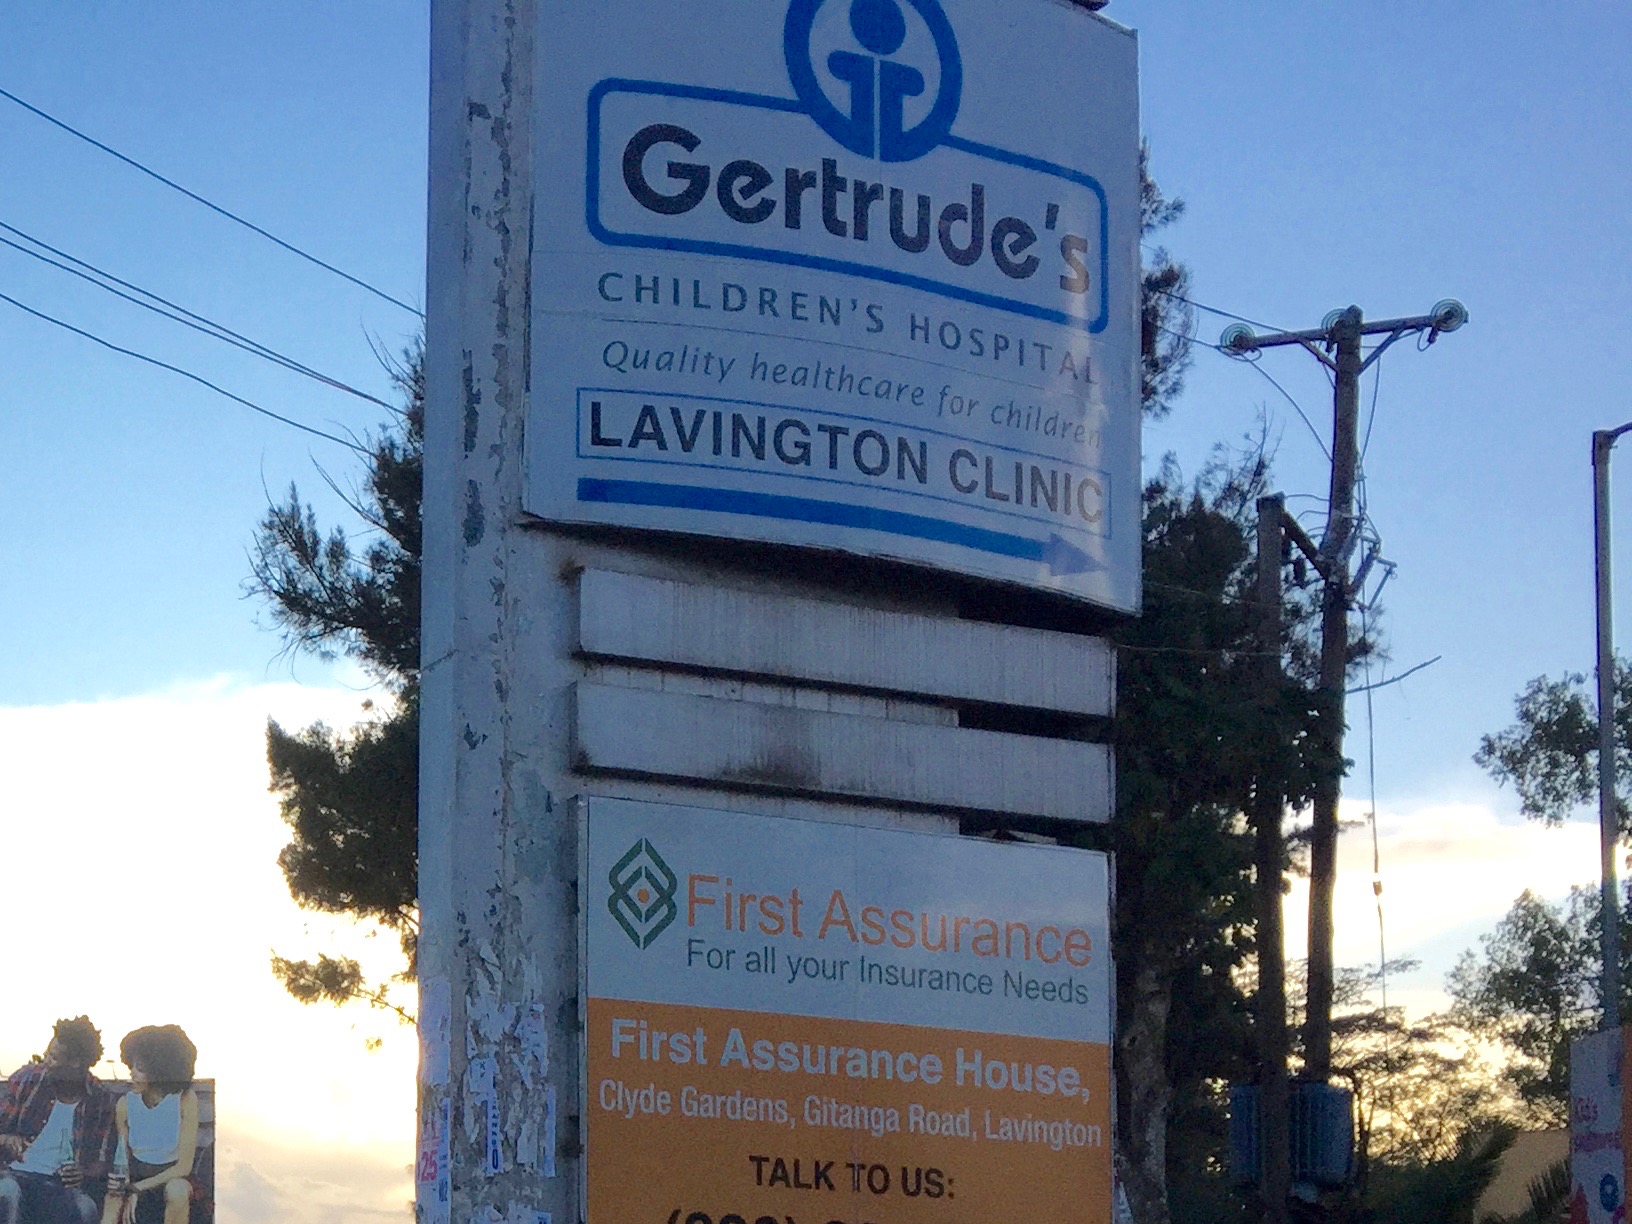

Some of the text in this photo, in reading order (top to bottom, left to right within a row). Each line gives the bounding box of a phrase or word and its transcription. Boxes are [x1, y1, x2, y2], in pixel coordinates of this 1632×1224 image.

[622, 123, 1091, 295] Gertrude's
[597, 271, 1099, 386] CHILDREN'S HOSPITAL
[602, 339, 1102, 451] Quality healthcare for children
[590, 401, 1104, 524] LAVINGTON CLINIC
[686, 872, 1093, 969] First Assurance
[686, 939, 1090, 1006] For all your Insurance Needs
[610, 1018, 1091, 1104] First Assurance House,
[599, 1079, 1102, 1152] Clyde Gardens, Gitanga Road, Lavington
[749, 1155, 956, 1200] TALK TO US:
